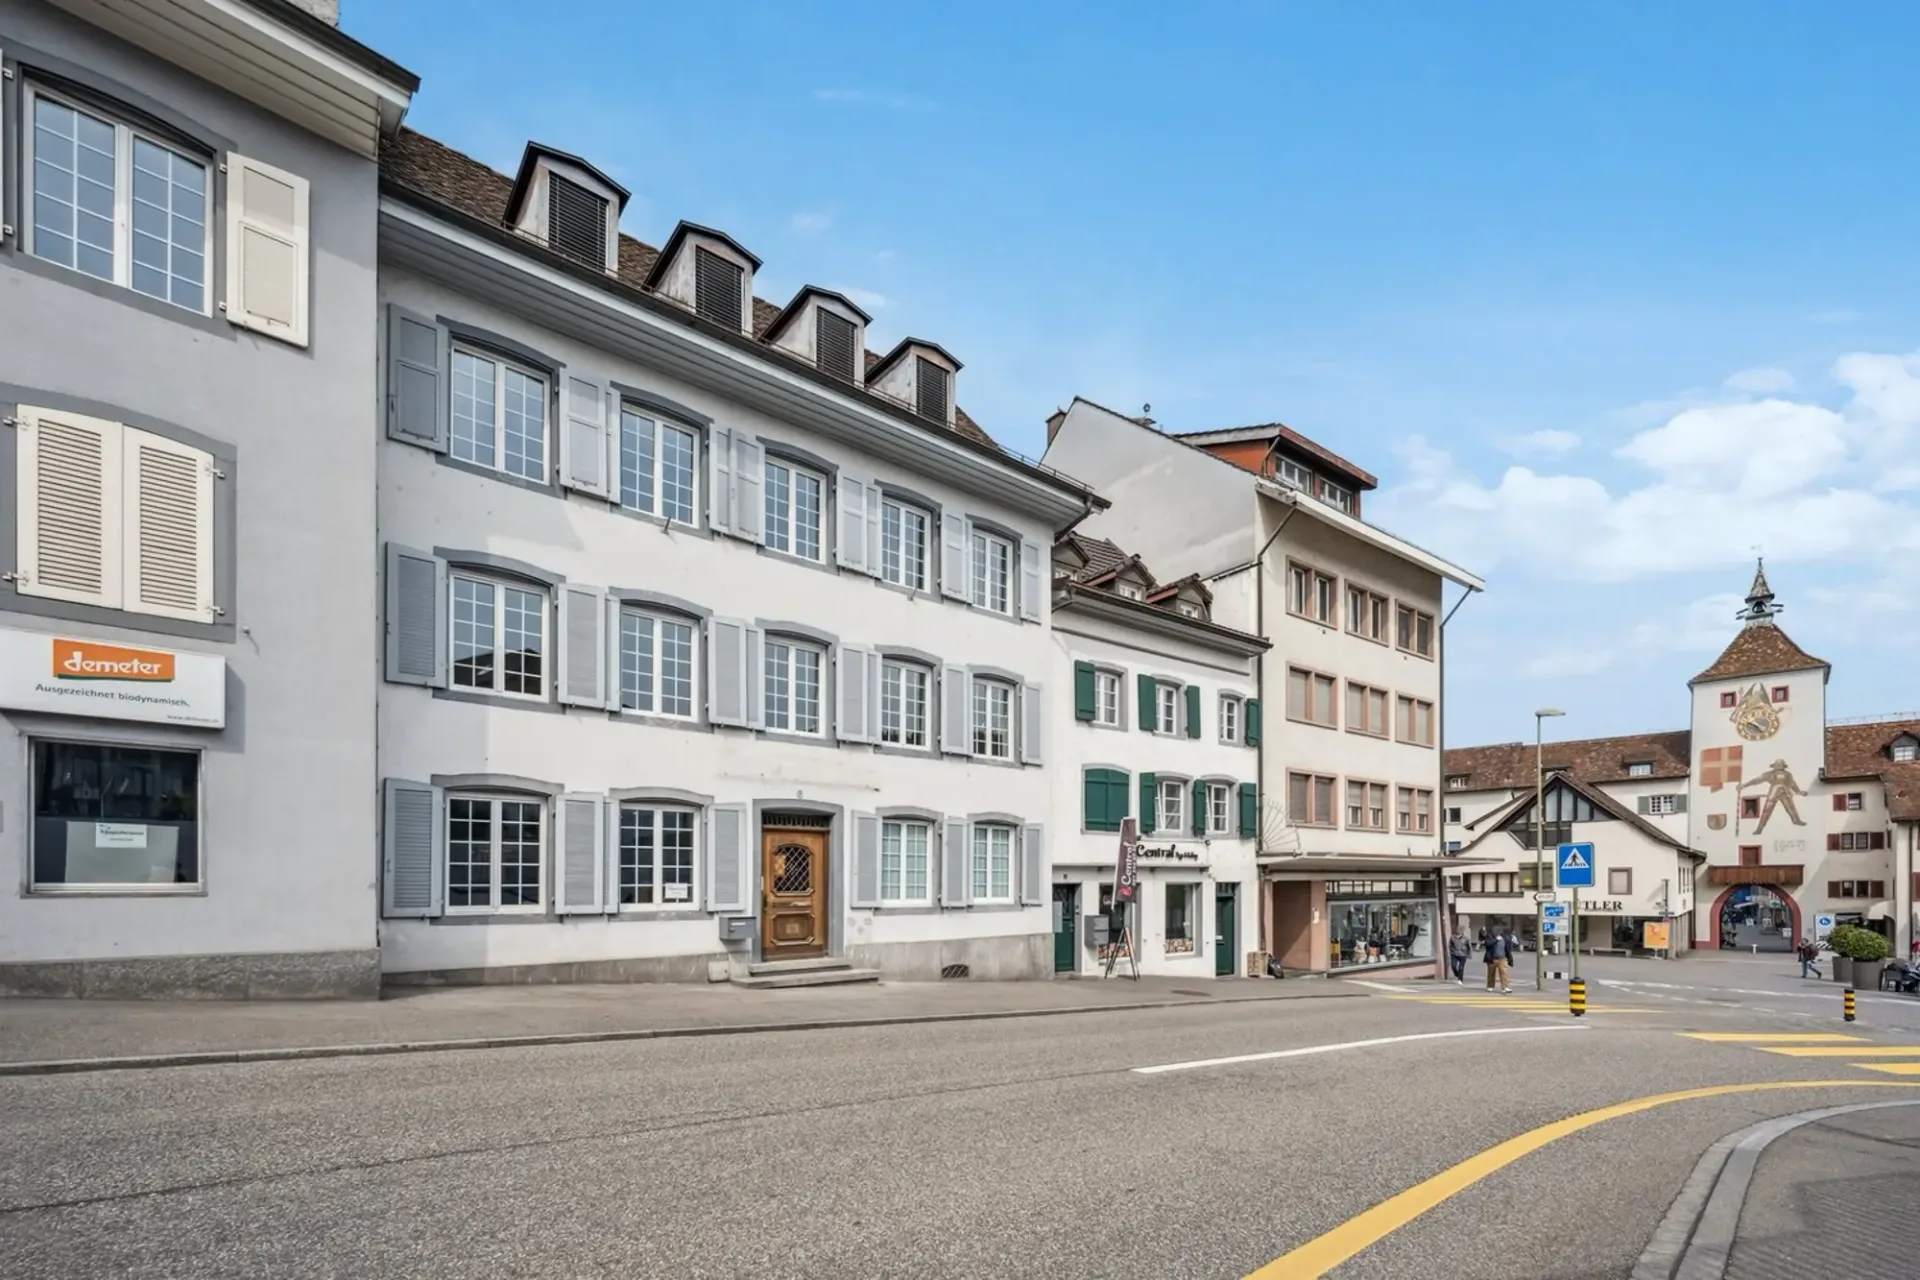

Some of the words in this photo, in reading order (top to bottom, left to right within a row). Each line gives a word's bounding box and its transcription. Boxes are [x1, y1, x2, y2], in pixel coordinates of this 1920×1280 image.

[63, 650, 163, 675] demeter
[35, 683, 115, 699] Ausgezeichnet
[118, 692, 191, 707] biodynamisch.
[1136, 843, 1176, 858] Central
[1121, 841, 1133, 885] Central
[1577, 900, 1623, 911] TLER
